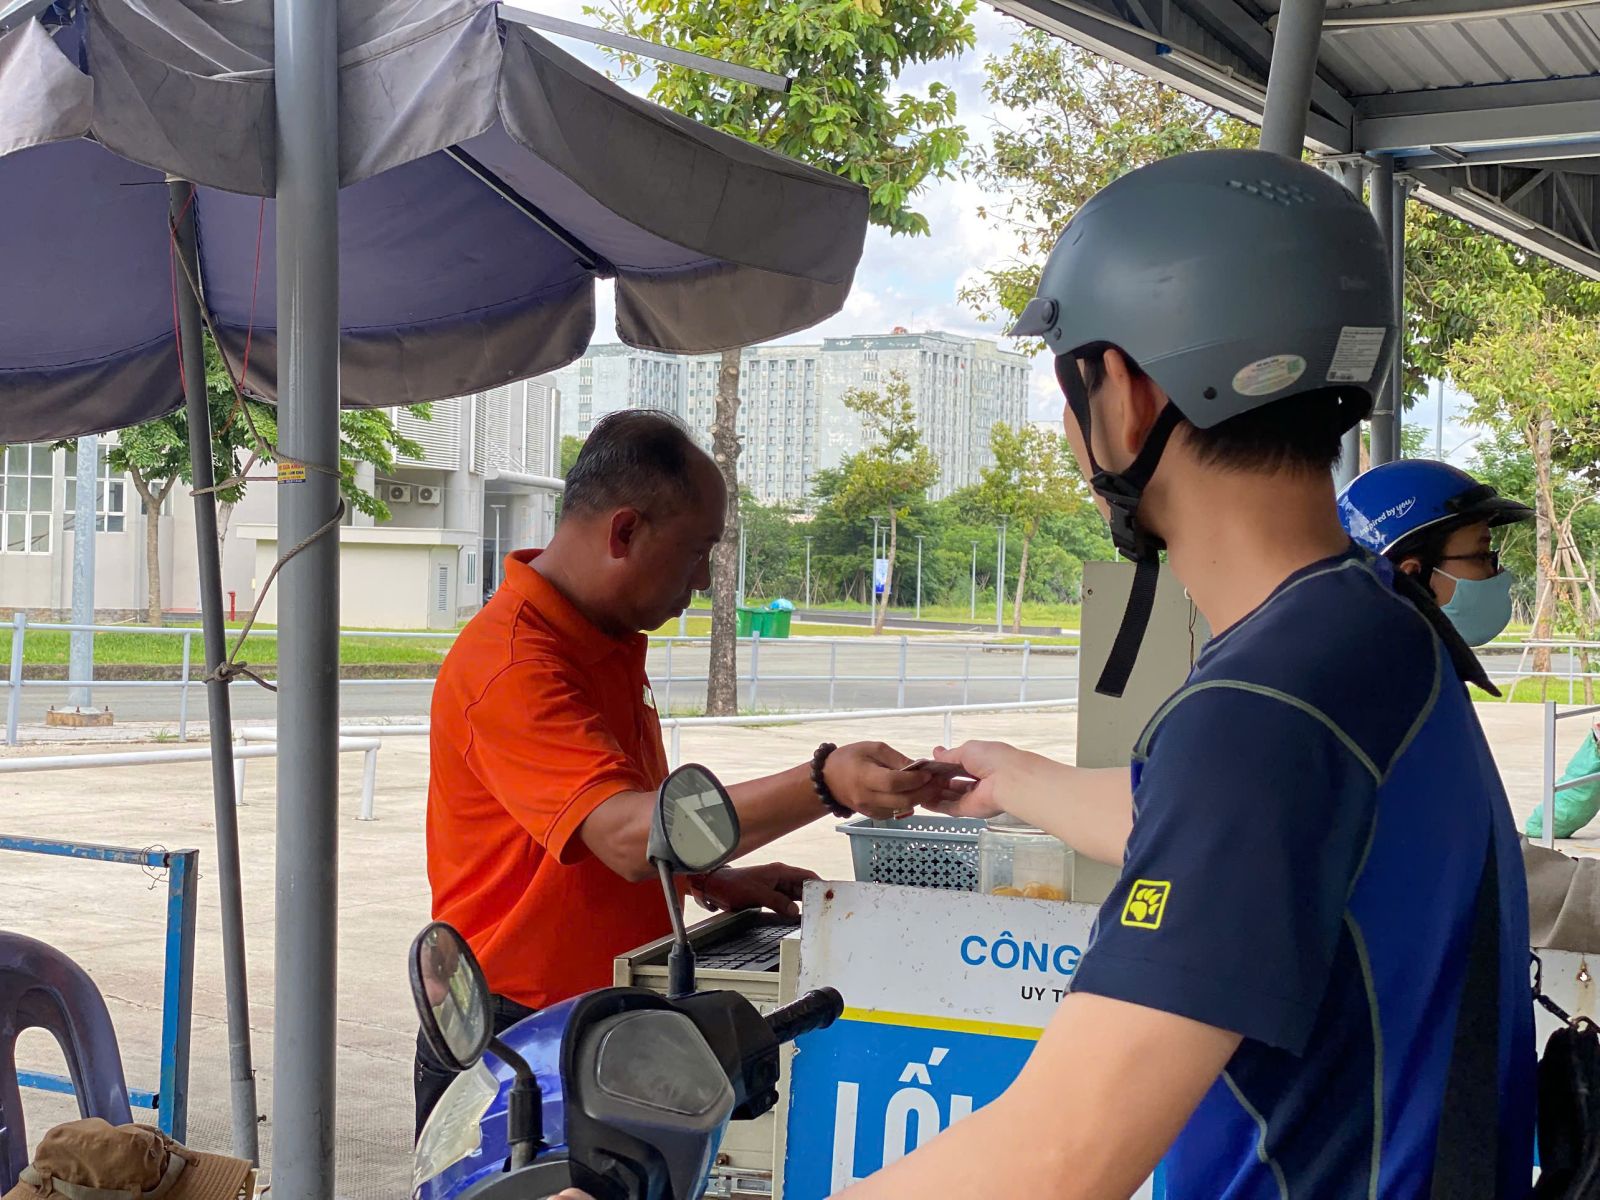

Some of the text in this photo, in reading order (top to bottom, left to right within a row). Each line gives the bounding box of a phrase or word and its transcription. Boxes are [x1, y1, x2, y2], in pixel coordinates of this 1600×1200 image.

[1386, 507, 1396, 517] by
[960, 930, 1081, 976] CÔNG
[1021, 986, 1046, 1001] UY
[830, 1047, 973, 1198] LỐ
